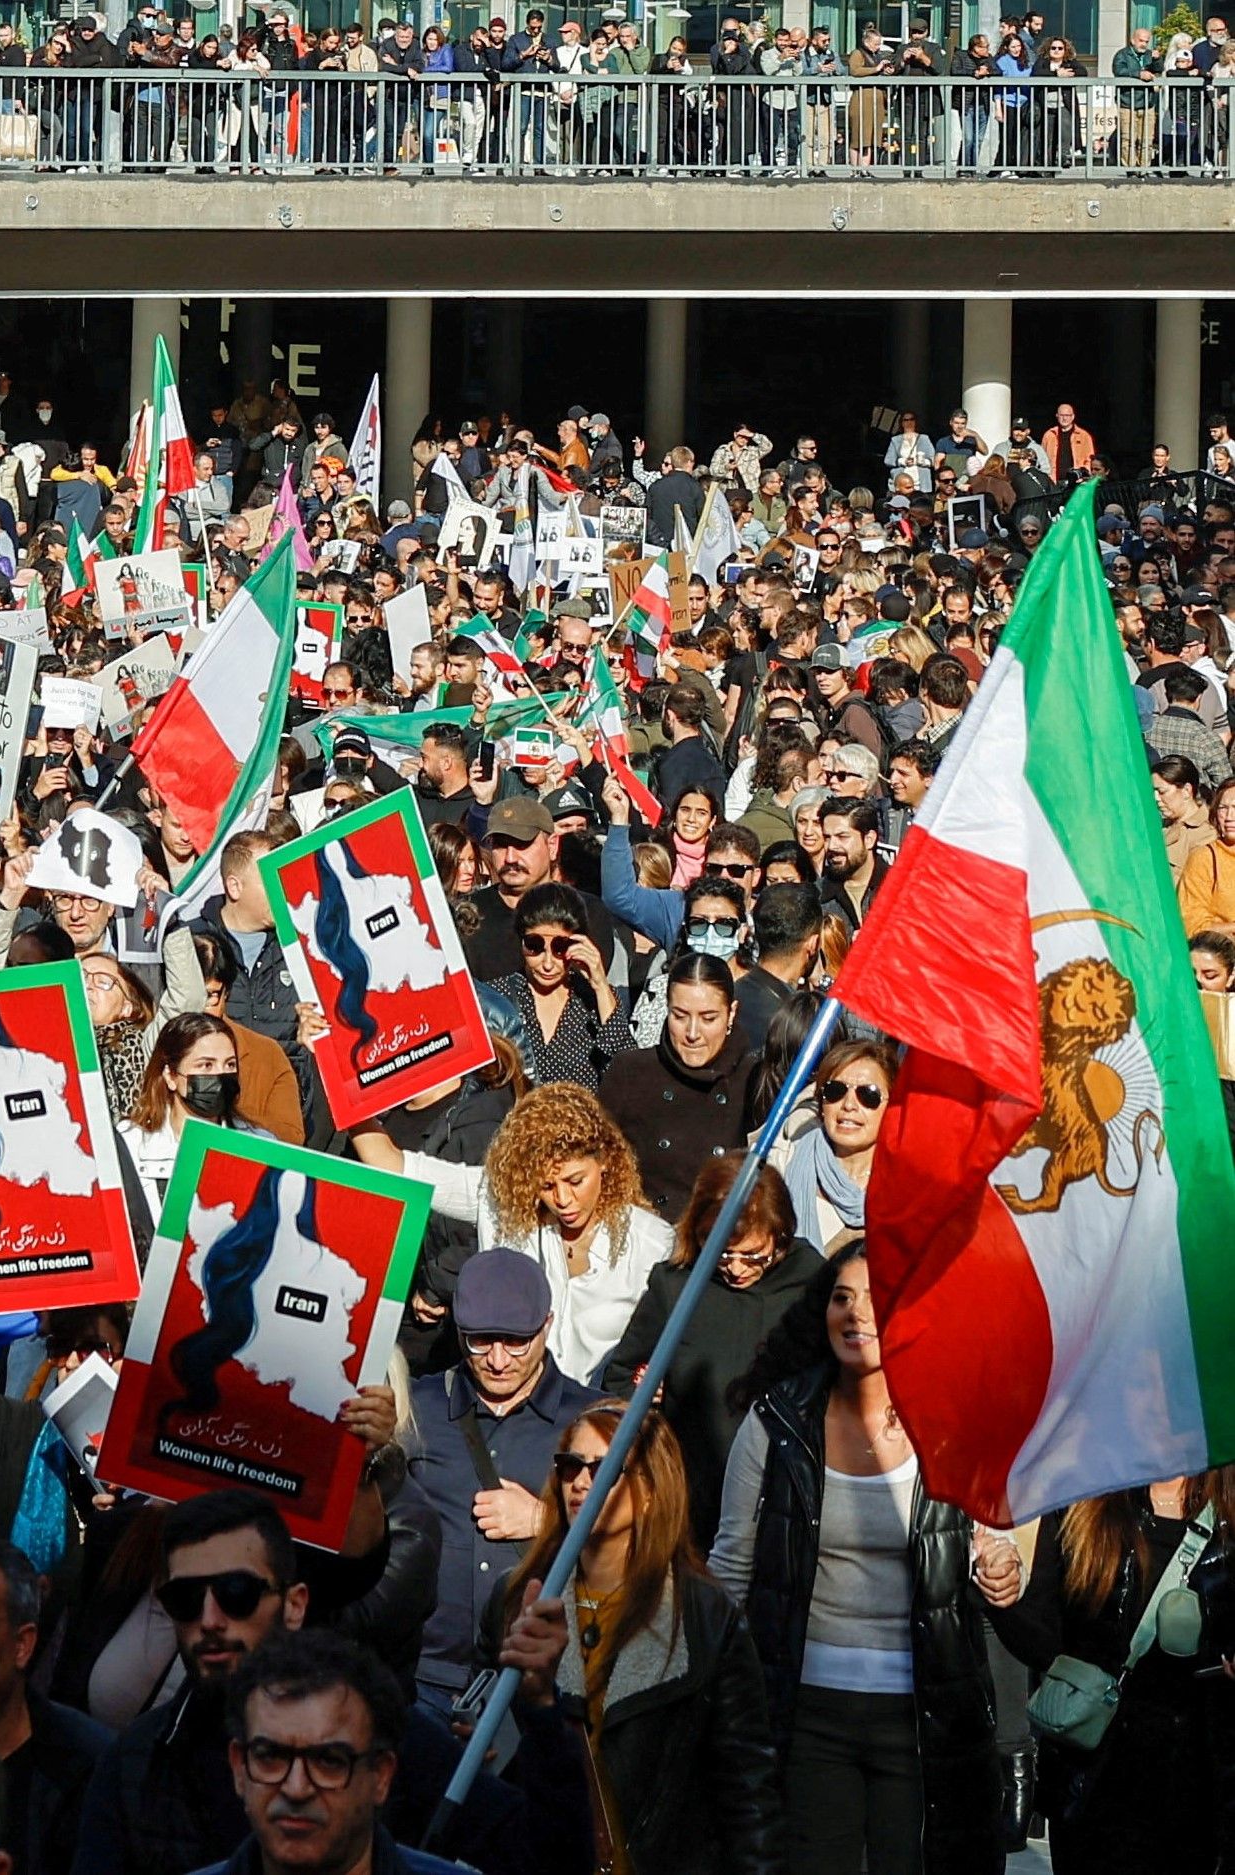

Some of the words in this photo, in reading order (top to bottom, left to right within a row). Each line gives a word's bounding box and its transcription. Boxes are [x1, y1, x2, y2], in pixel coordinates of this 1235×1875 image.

[0, 701, 13, 729] to
[369, 913, 395, 933] Iran
[360, 1058, 395, 1085] Women
[394, 1052, 411, 1070] life
[410, 1035, 450, 1062] freedom
[9, 1097, 41, 1114] Iran
[18, 1258, 38, 1273] life
[38, 1254, 89, 1271] freedom
[282, 1291, 320, 1316] Iran
[159, 1439, 211, 1466] Women
[212, 1453, 236, 1473] life
[237, 1463, 297, 1492] freedom
